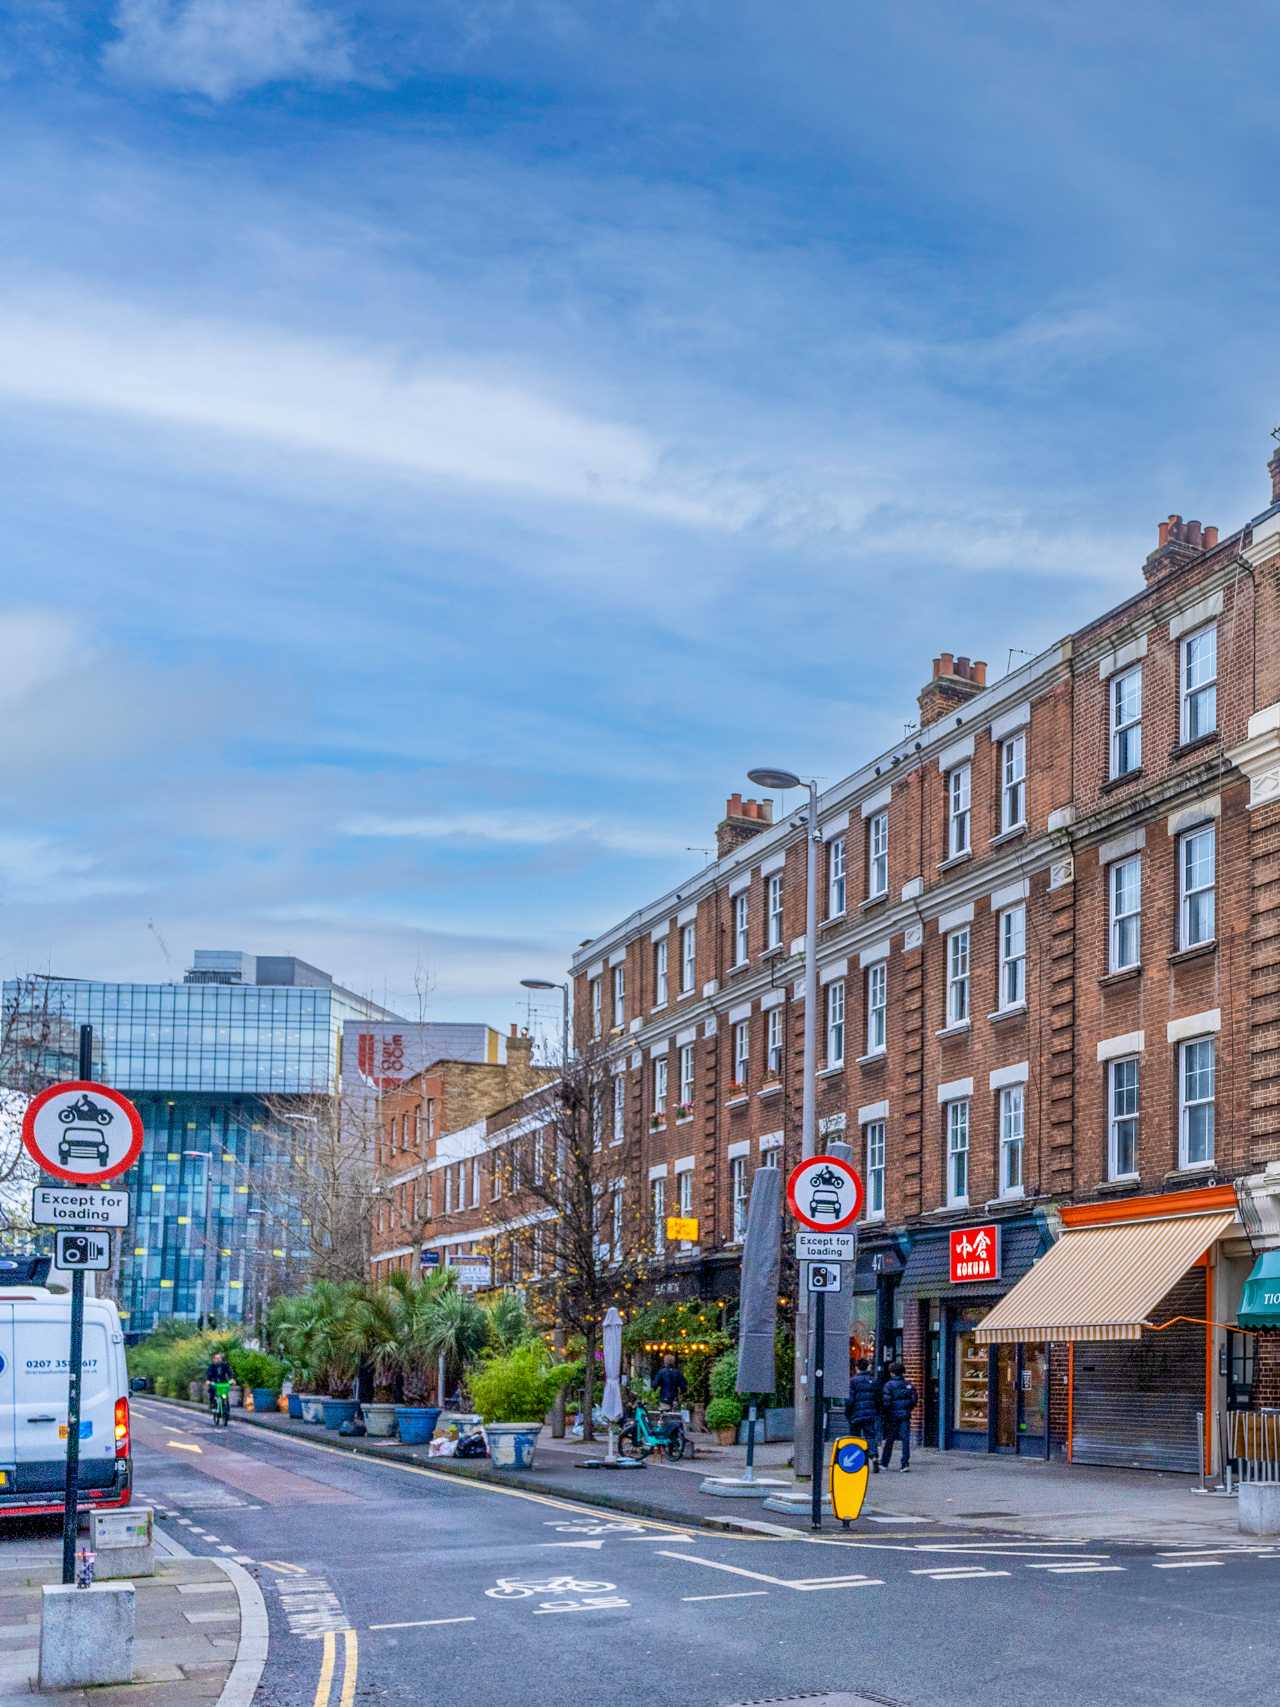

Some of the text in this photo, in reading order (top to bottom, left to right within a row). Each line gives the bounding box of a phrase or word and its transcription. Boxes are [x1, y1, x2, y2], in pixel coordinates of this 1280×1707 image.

[41, 1193, 122, 1207] Except for
[53, 1207, 109, 1222] loading
[800, 1236, 850, 1246] Except for
[807, 1247, 843, 1257] loading
[872, 1254, 884, 1271] 47
[956, 1260, 991, 1277] KOKURA
[26, 1360, 51, 1369] 0207
